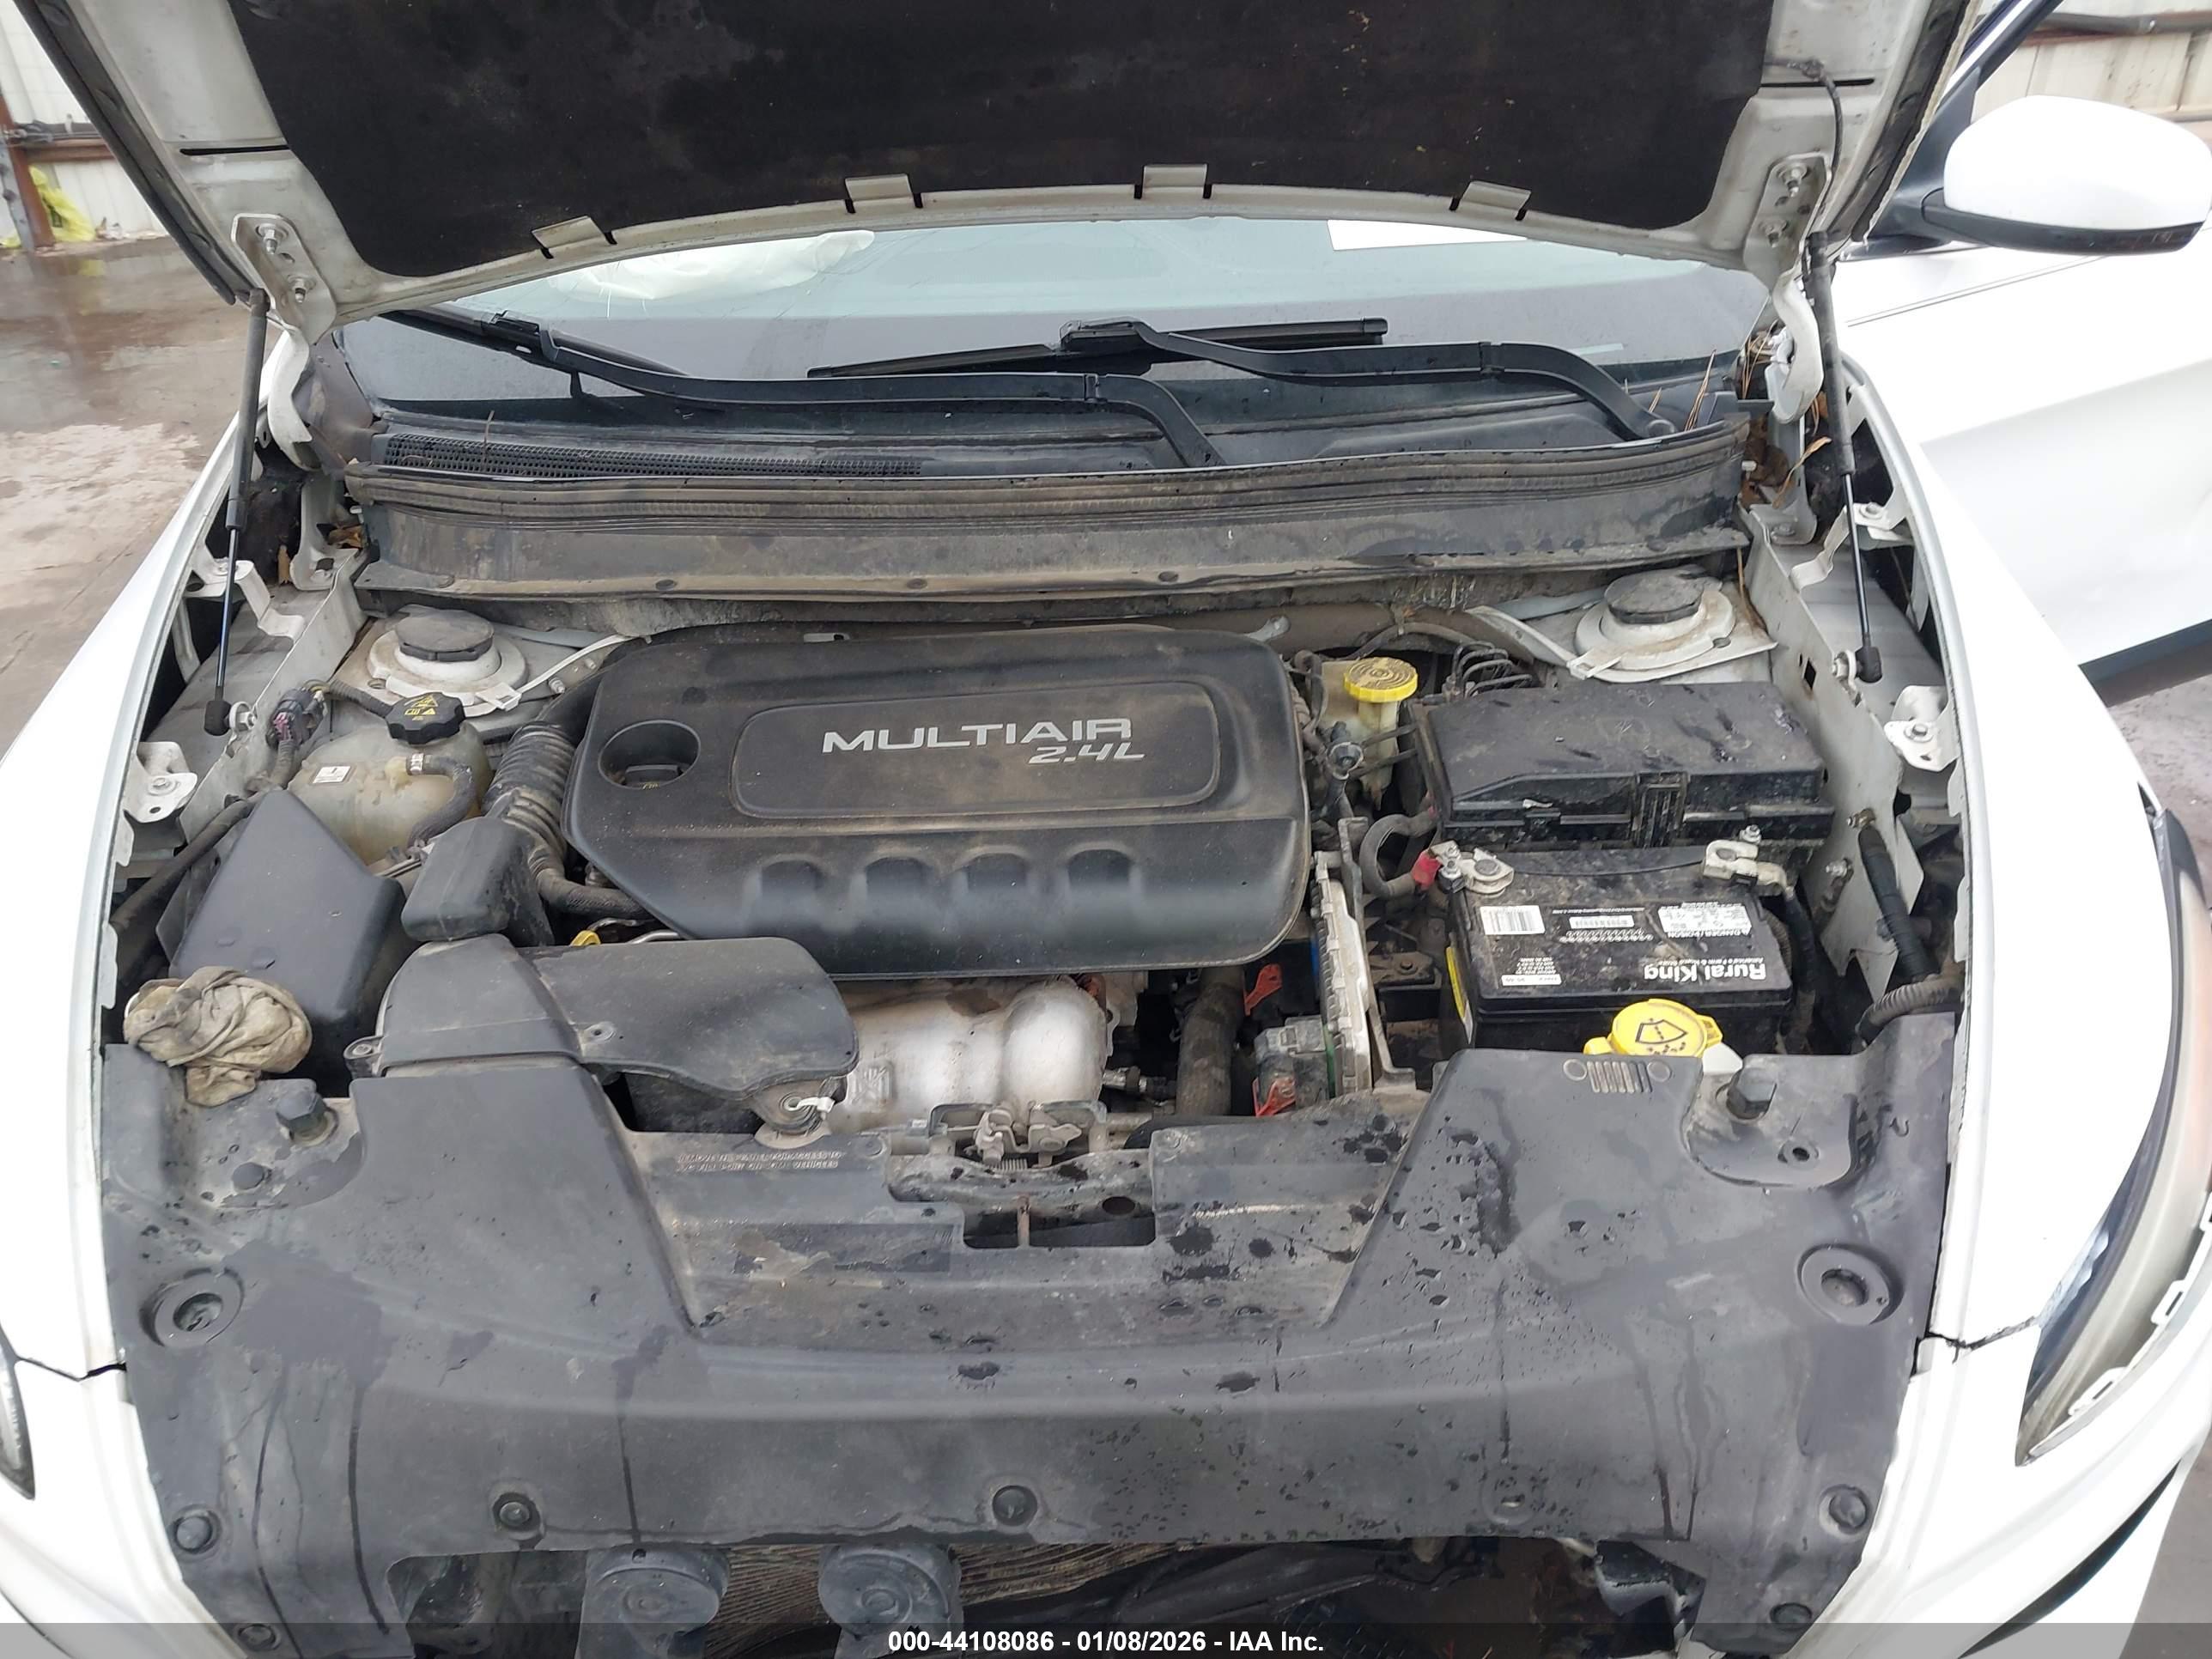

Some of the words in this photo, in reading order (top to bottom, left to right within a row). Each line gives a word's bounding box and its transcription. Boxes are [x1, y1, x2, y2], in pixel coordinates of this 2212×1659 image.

[822, 718, 1133, 754] MULTIAIR
[1028, 741, 1146, 764] 2.4L
[1644, 963, 1698, 982] King
[1705, 963, 1766, 981] Rural
